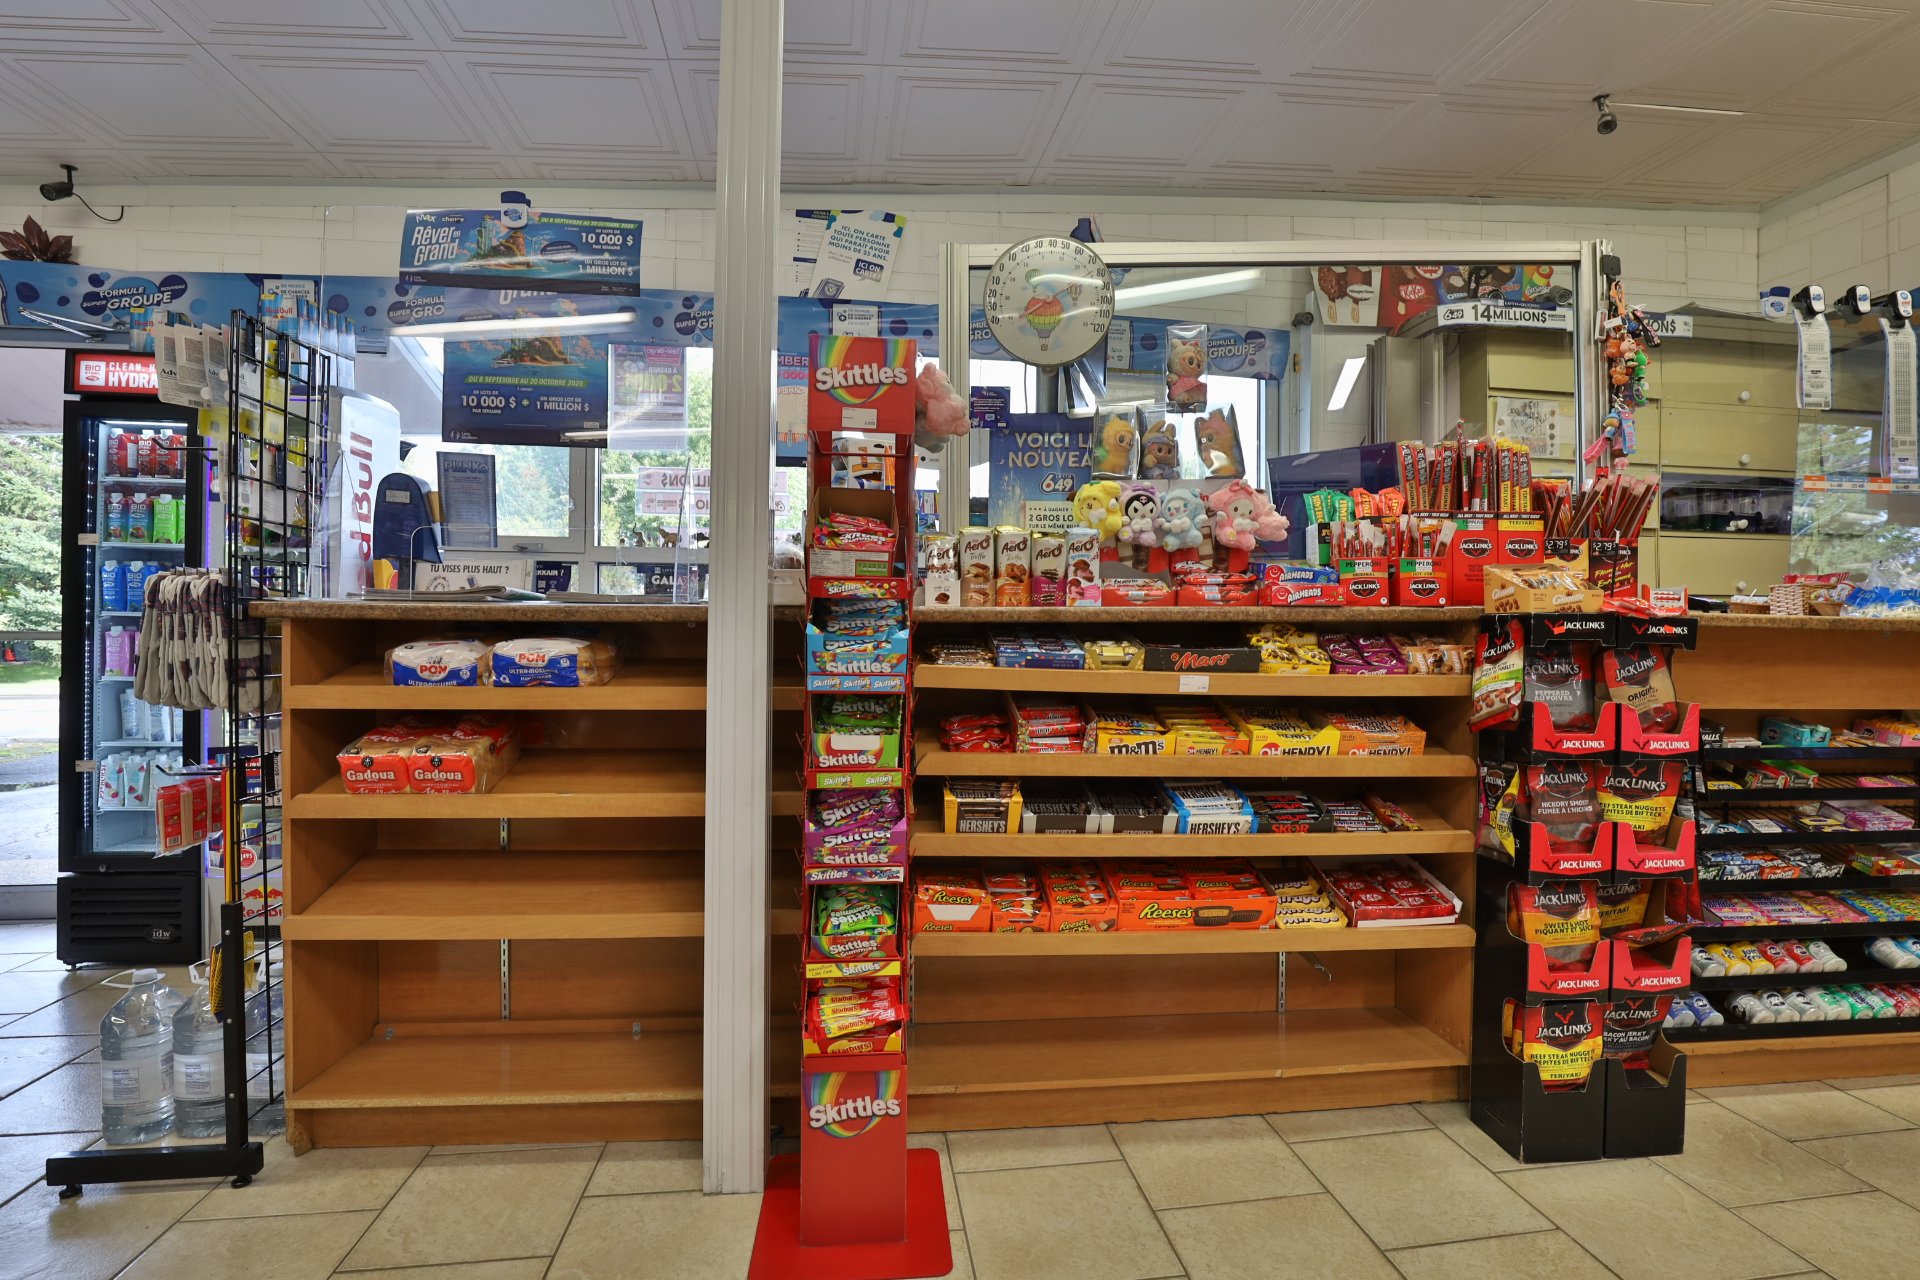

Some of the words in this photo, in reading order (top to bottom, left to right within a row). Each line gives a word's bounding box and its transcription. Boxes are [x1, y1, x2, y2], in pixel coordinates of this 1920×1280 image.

[411, 226, 456, 246] Rêver
[581, 233, 596, 243] 10
[599, 233, 623, 245] 000
[626, 235, 634, 246] $
[834, 229, 854, 239] TOUTE
[855, 234, 891, 249] PERSONNE
[865, 232, 886, 241] CARTE
[828, 241, 852, 251] MOINS
[830, 235, 843, 243] QUI
[869, 244, 890, 255] AVOIR
[1020, 244, 1030, 253] 20
[1034, 240, 1043, 248] 30
[1048, 240, 1058, 248] 40
[1061, 240, 1071, 250] 50
[414, 239, 459, 265] Grand
[1074, 246, 1084, 256] 60
[1008, 253, 1017, 261] 10
[1088, 255, 1097, 265] 70
[858, 261, 868, 269] ICI
[999, 263, 1005, 272] 0
[586, 265, 625, 276] MILLION
[627, 267, 633, 277] $
[1096, 269, 1106, 278] 80
[99, 287, 145, 299] FORMULE
[107, 291, 172, 310] GROUPE
[405, 295, 445, 308] FORMULE
[1100, 295, 1113, 305] 100
[389, 309, 411, 317] SUPER
[1099, 309, 1110, 319] 110
[1472, 304, 1493, 322] 14
[1493, 311, 1547, 323] MILLION$
[675, 320, 696, 328] SUPER
[1093, 323, 1105, 333] 120
[1209, 344, 1256, 358] GROUPE
[484, 376, 519, 384] SEPTEMBRE
[539, 378, 566, 386] OCTOBRE
[568, 379, 583, 387] 2025
[815, 362, 908, 391] Skittles
[462, 395, 477, 407] 10
[480, 395, 505, 407] 000
[509, 396, 516, 408] $
[536, 401, 540, 409] 1
[543, 401, 582, 411] MILLION
[584, 403, 590, 412] $
[1015, 432, 1070, 449] VOICI
[1035, 514, 1060, 522] GROS
[964, 534, 992, 554] Aero
[1001, 536, 1029, 555] Aero
[1068, 536, 1094, 554] Aero
[1035, 543, 1064, 561] Aero
[430, 564, 440, 572] TU
[442, 564, 461, 573] VISES
[463, 564, 481, 573] PLUS
[482, 565, 503, 574] HAUT
[504, 565, 509, 574] ?
[1279, 570, 1314, 582] AIRHEADS
[828, 583, 861, 595] Skittles
[1287, 587, 1322, 603] AIRHEADS
[826, 618, 898, 632] Skittles
[825, 659, 892, 673] Skittles
[1174, 651, 1231, 671] Mars
[420, 664, 448, 675] POM
[813, 677, 841, 687] Skittles
[844, 677, 871, 688] Skittles
[873, 678, 901, 688] Skittles
[1562, 740, 1582, 748] JACK
[1582, 740, 1605, 748] LINK'S
[1649, 741, 1668, 749] JACK
[1668, 740, 1690, 748] LINK'S
[1186, 747, 1196, 755] OH
[1196, 747, 1218, 755] HENRY!
[818, 751, 877, 768] Skittles
[346, 769, 395, 782] Gadoua
[414, 768, 462, 781] Gadoua
[866, 775, 893, 785] Skittles
[823, 776, 852, 786] Skittles
[821, 793, 892, 827] Skittles
[1027, 802, 1079, 815] HERSHEY'S
[1538, 807, 1560, 815] FUMÉE
[1612, 803, 1633, 811] STEAK
[958, 819, 1005, 833] HERSHEY'S
[1189, 822, 1241, 834] HERSHEY'S
[1271, 824, 1310, 834] SKOR
[823, 850, 889, 864] Skittles
[1559, 860, 1578, 869] JACK
[1578, 859, 1602, 868] LINK'S
[1644, 859, 1663, 868] JACK
[1663, 858, 1685, 867] LINK'S
[810, 867, 849, 881] Skittles
[1119, 879, 1154, 887] Reese's
[1196, 879, 1229, 888] Reese's
[933, 889, 972, 905] Reese's
[1139, 902, 1194, 919] Reese's
[1283, 915, 1340, 925] Mirage
[922, 921, 954, 931] Reese's
[152, 928, 171, 938] idw
[829, 940, 879, 955] Skittles
[842, 962, 880, 976] Skittles
[1557, 979, 1576, 988] JACK
[1576, 979, 1600, 987] LINK'S
[1640, 977, 1659, 986] JACK
[1659, 976, 1681, 985] LINK'S
[809, 1096, 902, 1129] Skittles
